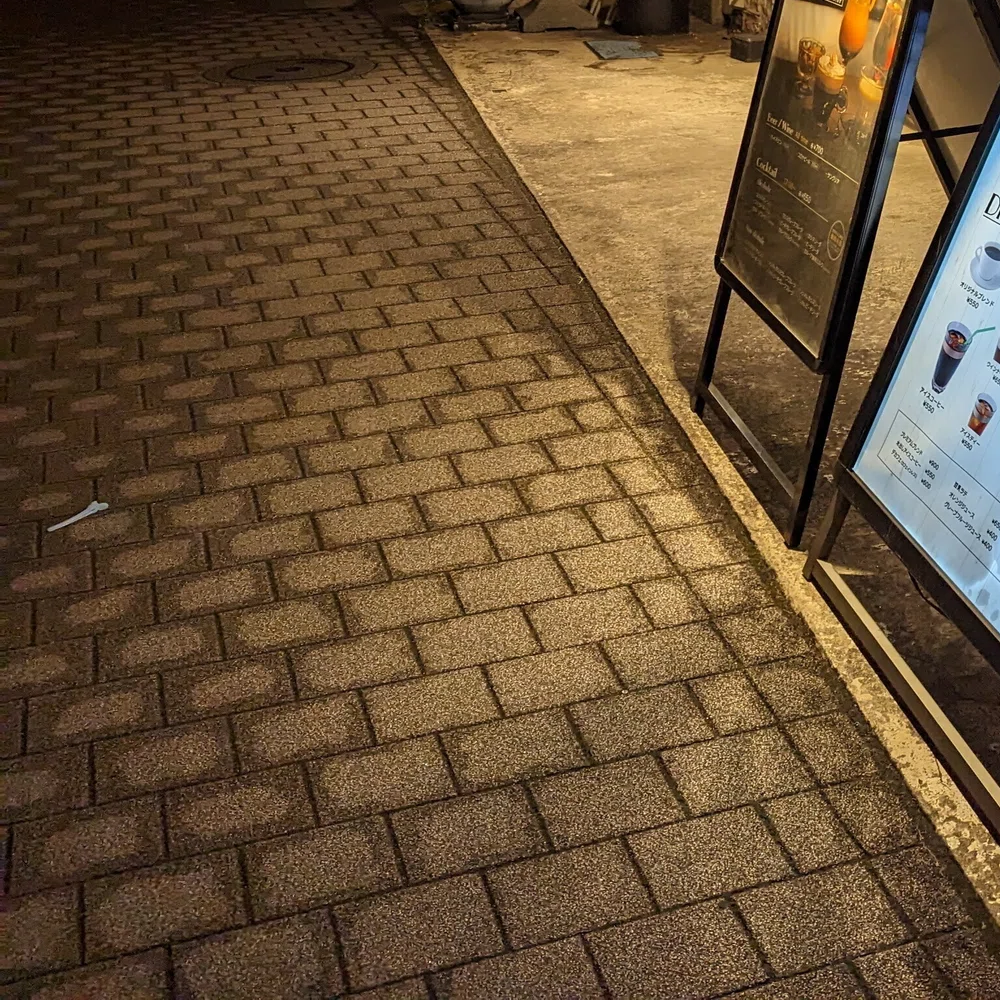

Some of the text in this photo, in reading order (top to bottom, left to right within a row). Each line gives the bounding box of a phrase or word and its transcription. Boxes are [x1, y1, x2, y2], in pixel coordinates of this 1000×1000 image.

[959, 281, 995, 307] オリジナルブレンド
[966, 296, 980, 310] ¥550
[919, 386, 945, 410] アイスコーヒー
[959, 427, 981, 447] アイスティー
[948, 491, 976, 520] オレンジジュース
[944, 501, 982, 542] グレープフルーツジュース
